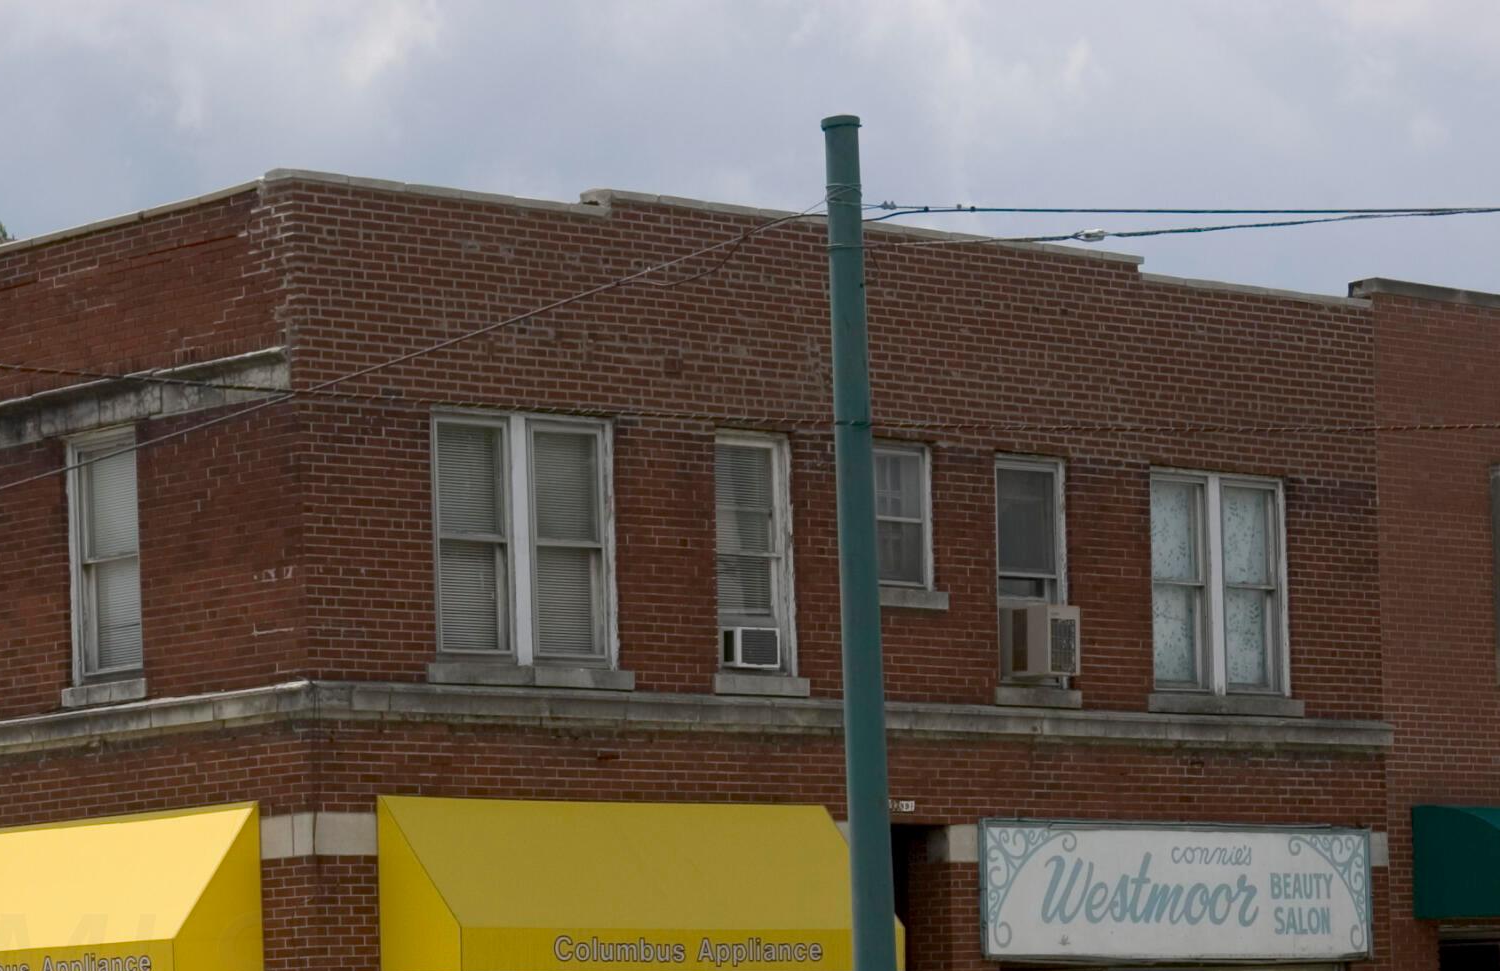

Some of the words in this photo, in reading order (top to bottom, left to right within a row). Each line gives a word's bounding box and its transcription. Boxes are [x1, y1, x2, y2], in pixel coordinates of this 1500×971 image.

[1041, 852, 1259, 927] Westmoor
[1270, 872, 1334, 900] BEAUTY
[1274, 907, 1331, 935] SALON
[554, 935, 686, 963] Columbus
[697, 937, 824, 967] Appliance
